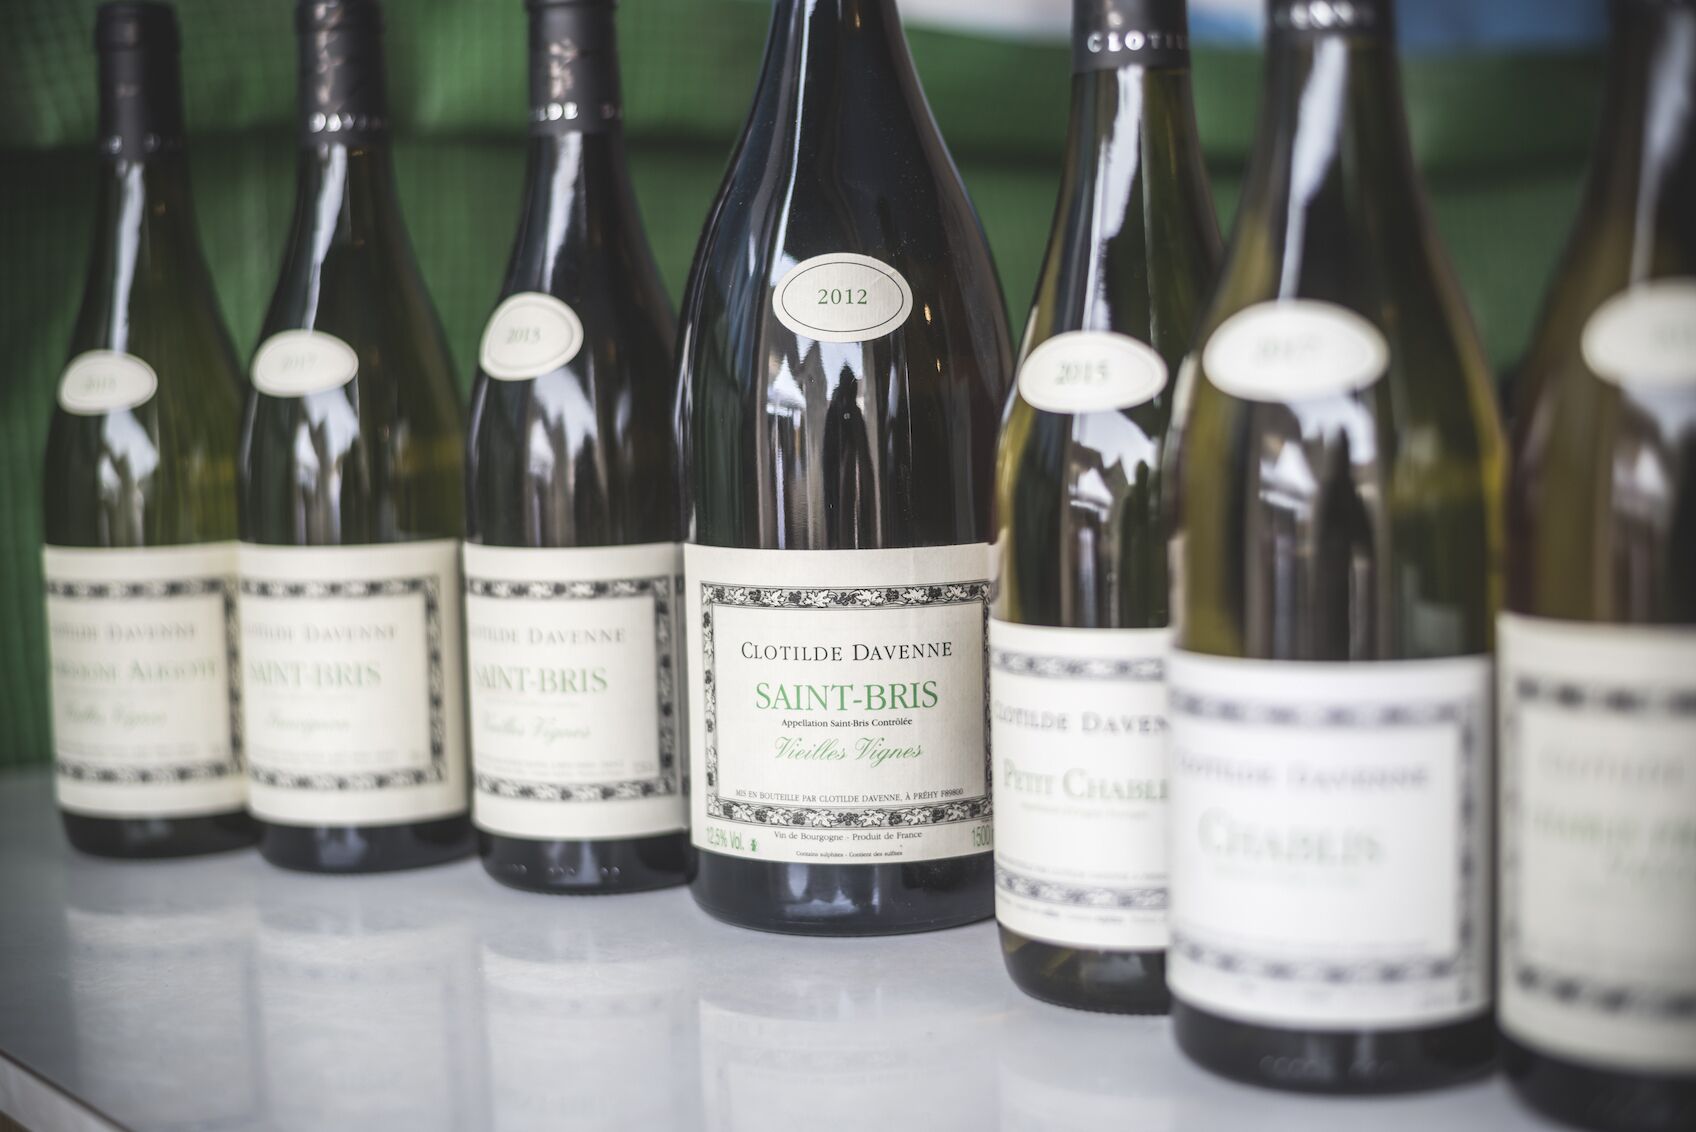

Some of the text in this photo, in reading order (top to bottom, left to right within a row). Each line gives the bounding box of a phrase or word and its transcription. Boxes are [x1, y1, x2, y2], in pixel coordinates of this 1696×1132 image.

[817, 288, 868, 305] 2012
[528, 625, 626, 645] DAVENNE
[741, 641, 953, 662] CLOTILDE DAVENNE
[755, 680, 938, 711] SAINT-BRIS
[781, 717, 913, 729] Appellation Saint-Bris Contrôlée
[774, 736, 924, 769] Vieilles Vignes
[735, 788, 747, 798] MIS
[748, 790, 758, 799] EN
[759, 791, 799, 802] BOUTEILLE
[802, 793, 817, 803] PAR
[819, 794, 859, 804] CLOTILDE
[905, 791, 911, 801] À
[913, 789, 938, 800] PRÉHY
[774, 830, 788, 840] Vin
[788, 831, 798, 840] de
[800, 832, 844, 843] Bourgogne
[852, 832, 882, 842] Produit
[884, 831, 894, 841] de
[896, 831, 923, 840] France
